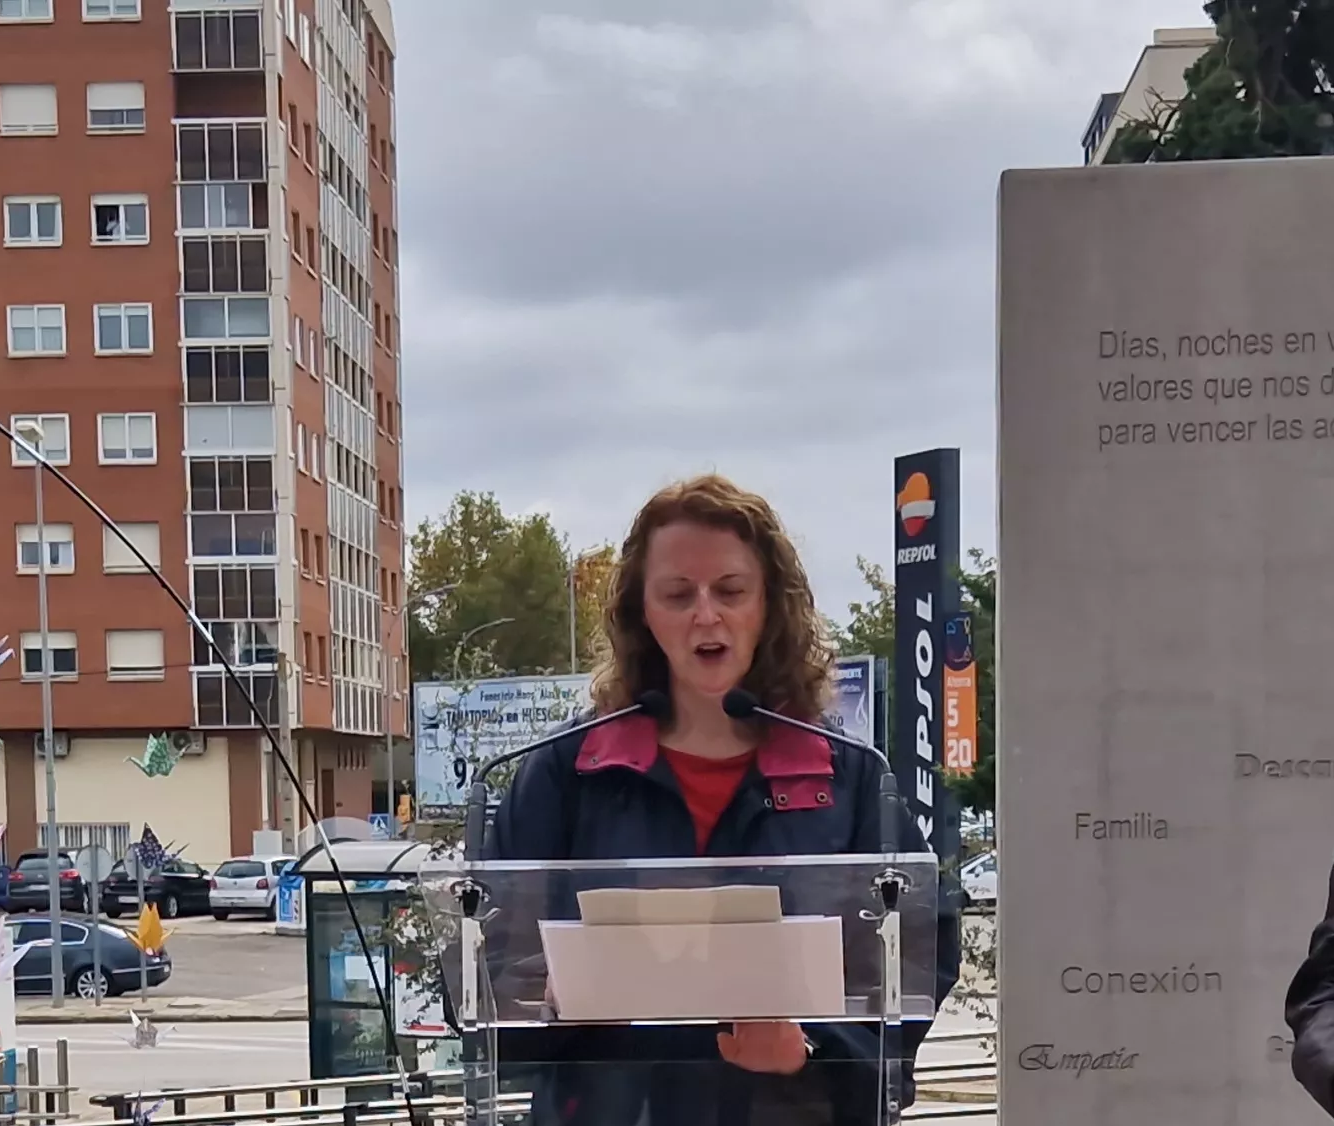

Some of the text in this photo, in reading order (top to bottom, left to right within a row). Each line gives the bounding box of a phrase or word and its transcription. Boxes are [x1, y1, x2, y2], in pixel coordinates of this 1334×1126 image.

[1098, 330, 1167, 361] Días,
[1178, 328, 1274, 357] noches
[1284, 331, 1316, 353] en
[1098, 374, 1194, 402] valores
[1203, 376, 1253, 405] que
[1262, 374, 1311, 398] nos
[1098, 421, 1157, 452] para
[1167, 419, 1258, 443] vencer
[1266, 413, 1304, 440] las
[897, 543, 937, 566] REPSOL
[947, 738, 972, 768] 20
[1074, 812, 1169, 840] Familia
[1061, 962, 1222, 994] Conexión
[1018, 1043, 1140, 1078] Empatía
